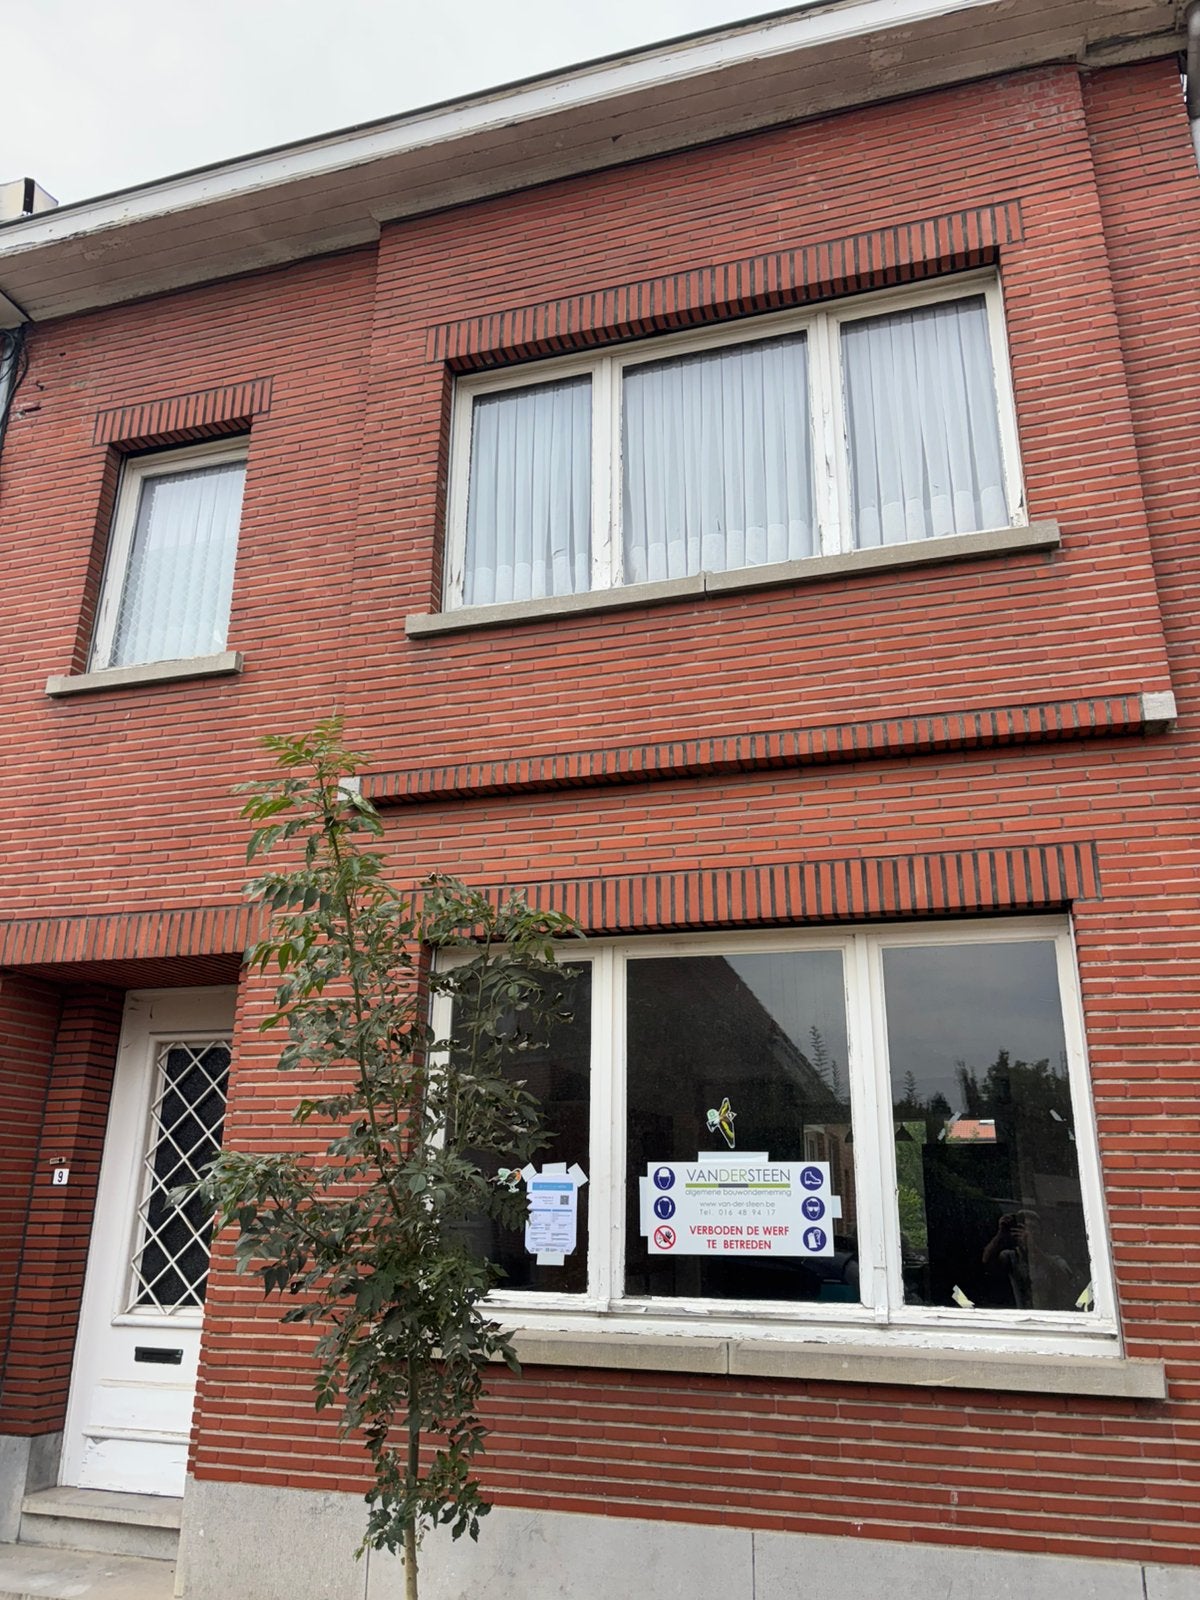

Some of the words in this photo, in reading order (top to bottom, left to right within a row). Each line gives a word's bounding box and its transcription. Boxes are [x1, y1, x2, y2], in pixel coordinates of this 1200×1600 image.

[57, 1171, 64, 1183] 9
[686, 1169, 791, 1182] VANDERSTEEN
[685, 1189, 721, 1197] algemene
[723, 1189, 792, 1197] bouwonderneming
[690, 1226, 743, 1235] VERBODEN
[747, 1226, 759, 1235] DE
[763, 1226, 790, 1236] WERF
[707, 1240, 717, 1249] TE
[723, 1240, 772, 1250] BETREDEN
